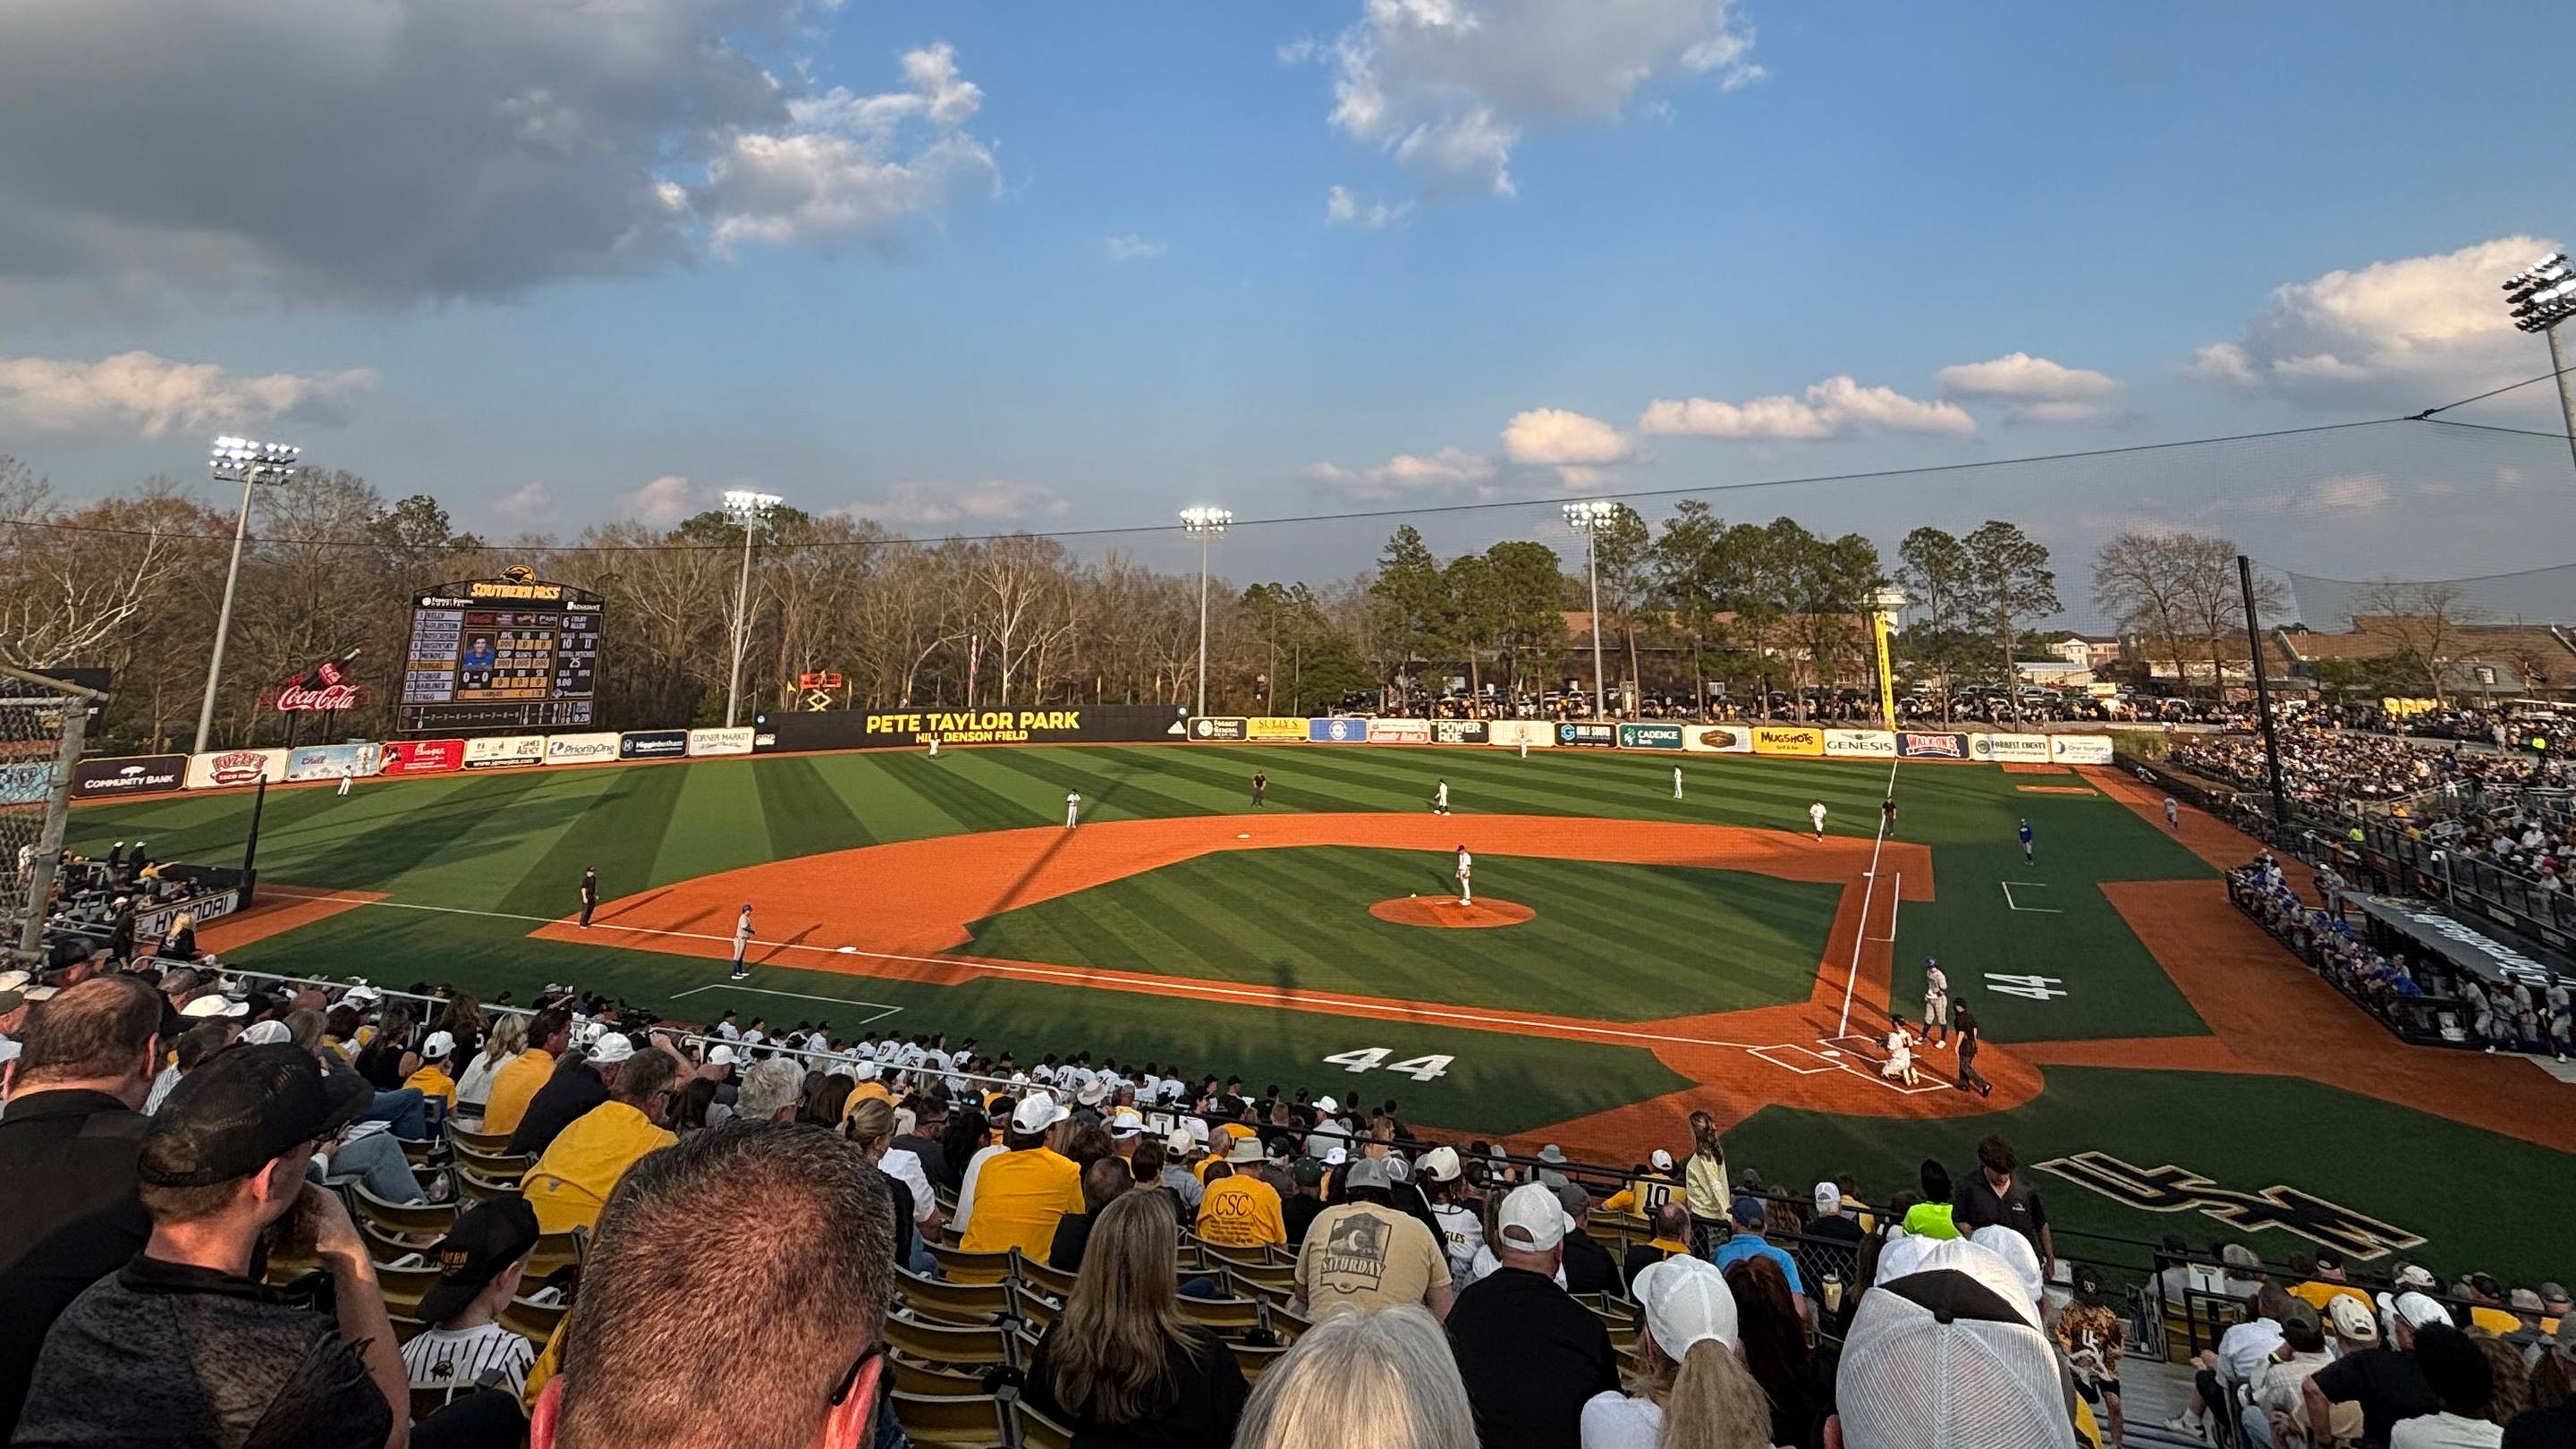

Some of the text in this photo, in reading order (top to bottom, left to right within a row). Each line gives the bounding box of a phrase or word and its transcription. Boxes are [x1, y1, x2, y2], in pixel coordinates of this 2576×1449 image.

[471, 583, 561, 599] SOUTHERN MISS
[563, 617, 569, 628] 6
[563, 639, 591, 648] 10 11
[570, 657, 580, 668] 25
[463, 672, 470, 682] 0
[481, 672, 488, 682] 0
[556, 678, 572, 687] 9.00
[866, 711, 1080, 733] PETE TAYLOR PARK
[1438, 722, 1482, 733] POWER
[723, 733, 750, 741] MARKET
[916, 731, 1029, 743] HILL DENSON FIELD
[1638, 730, 1678, 739] CADENCE
[1760, 732, 1814, 744] MUGSHOTS
[564, 744, 615, 755] PriorityOne
[1826, 741, 1893, 751] GENESIS
[212, 751, 268, 772] FUZZY'S
[85, 775, 174, 789] COMMUNITY BANK
[1322, 1047, 1455, 1082] 44
[1058, 1072, 1069, 1085] 24
[1646, 1183, 1671, 1207] 10
[1216, 1194, 1249, 1216] CSC
[1321, 1256, 1385, 1277] SATURDAY
